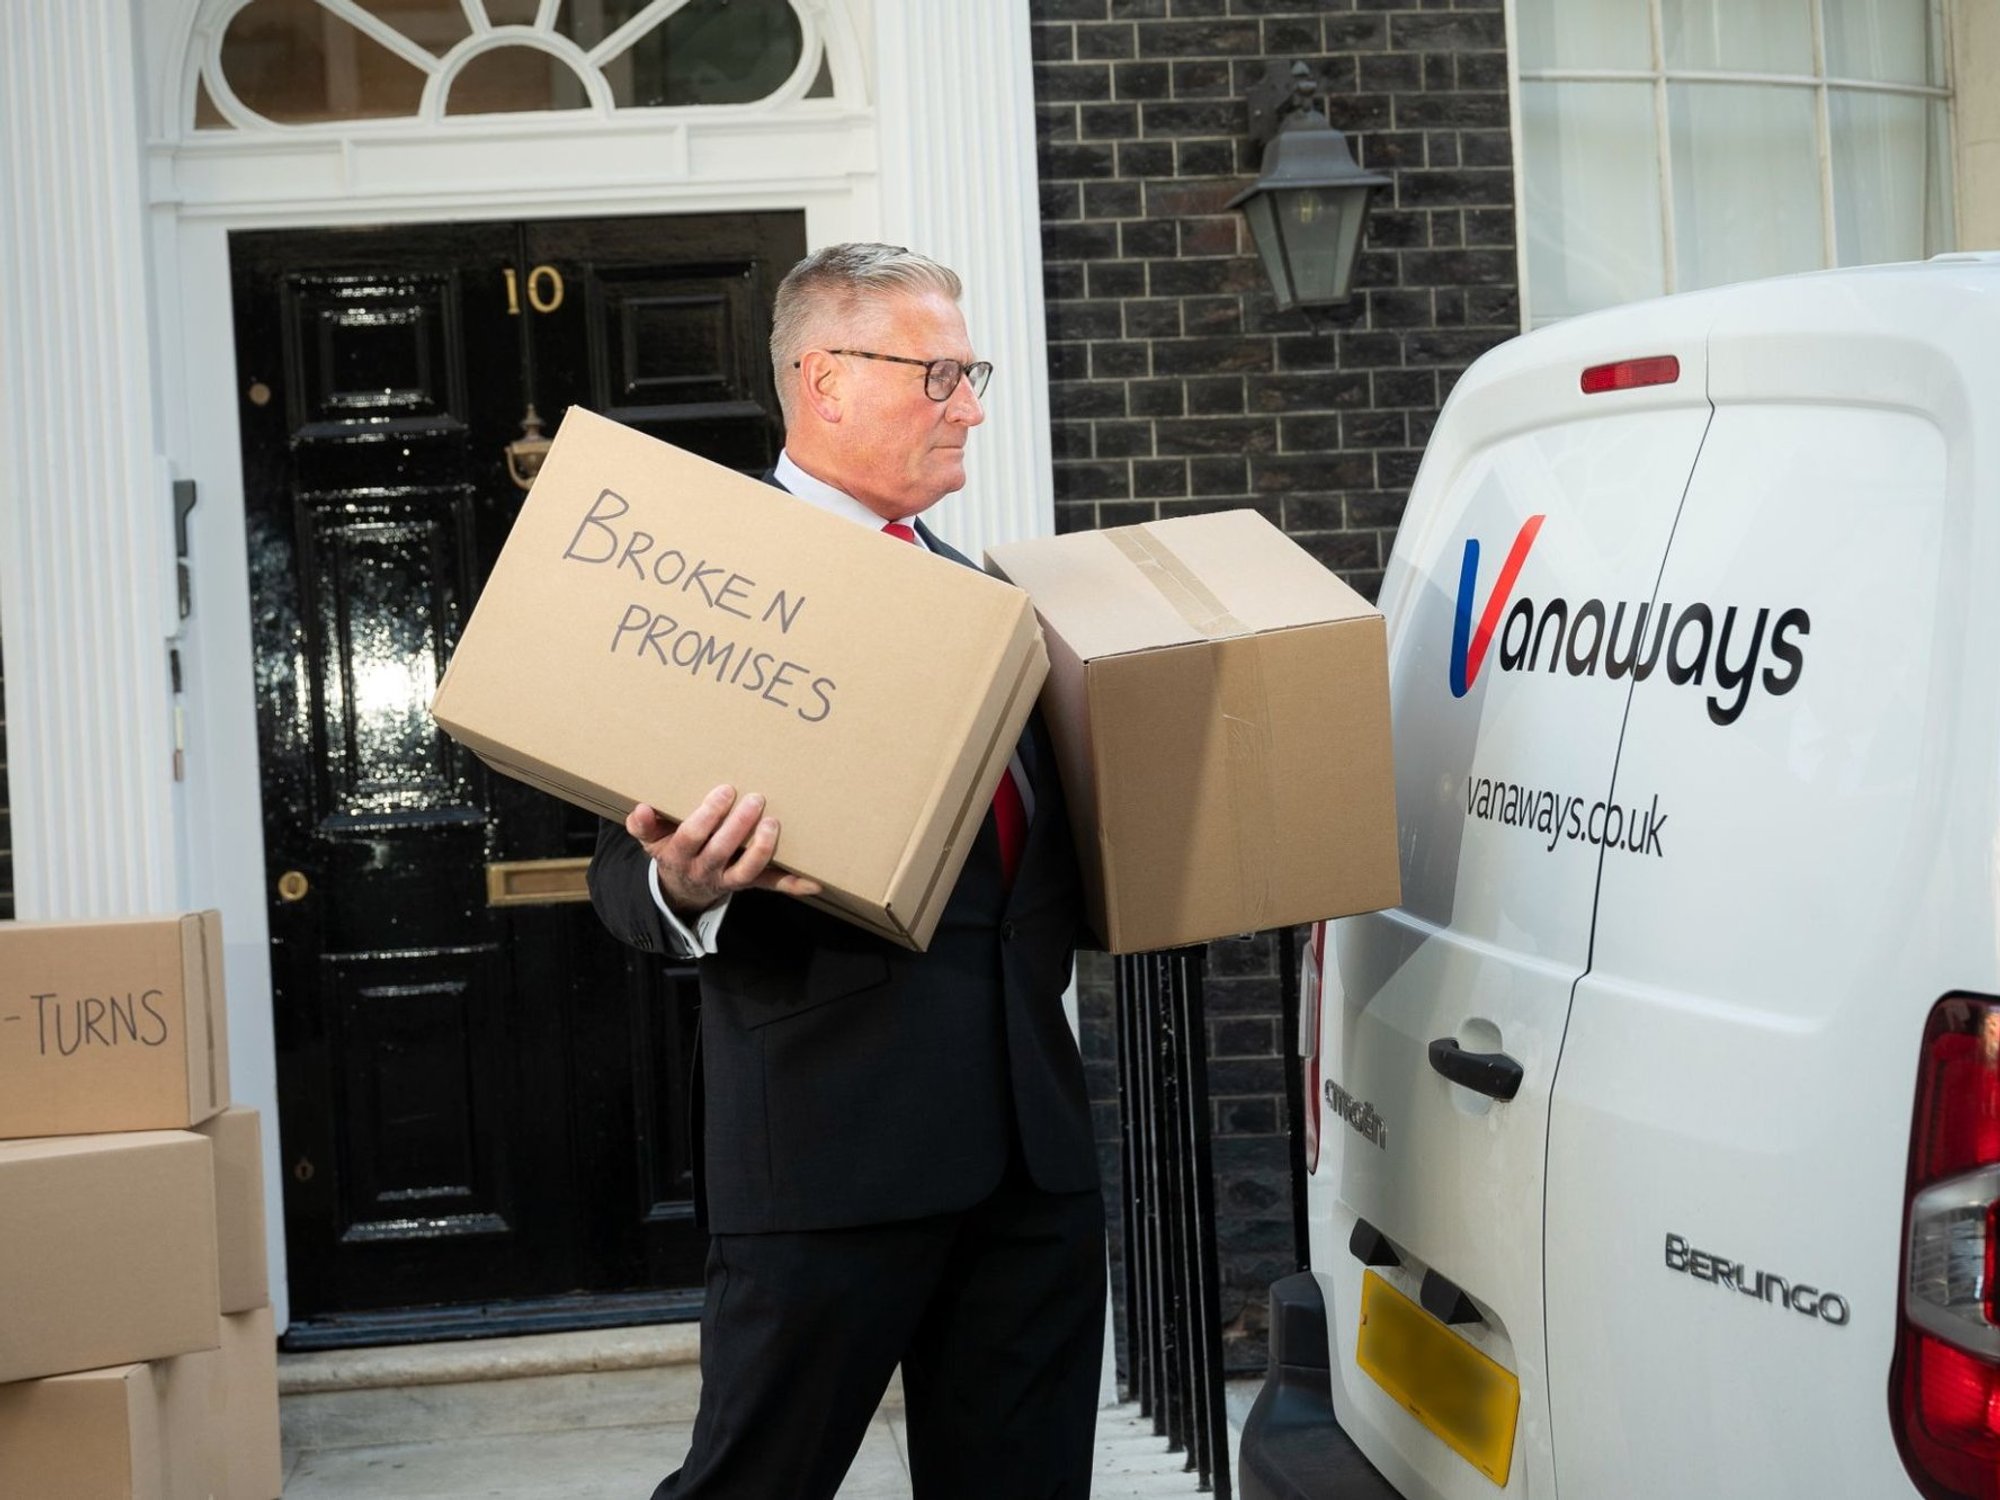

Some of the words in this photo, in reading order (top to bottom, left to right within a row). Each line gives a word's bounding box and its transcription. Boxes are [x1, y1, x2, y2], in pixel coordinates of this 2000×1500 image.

[502, 265, 564, 315] 10
[562, 488, 806, 634] BROKEN
[1449, 514, 1811, 726] Vanaways
[610, 604, 836, 722] PROMISES
[1467, 776, 1668, 858] vanaways.co.uk
